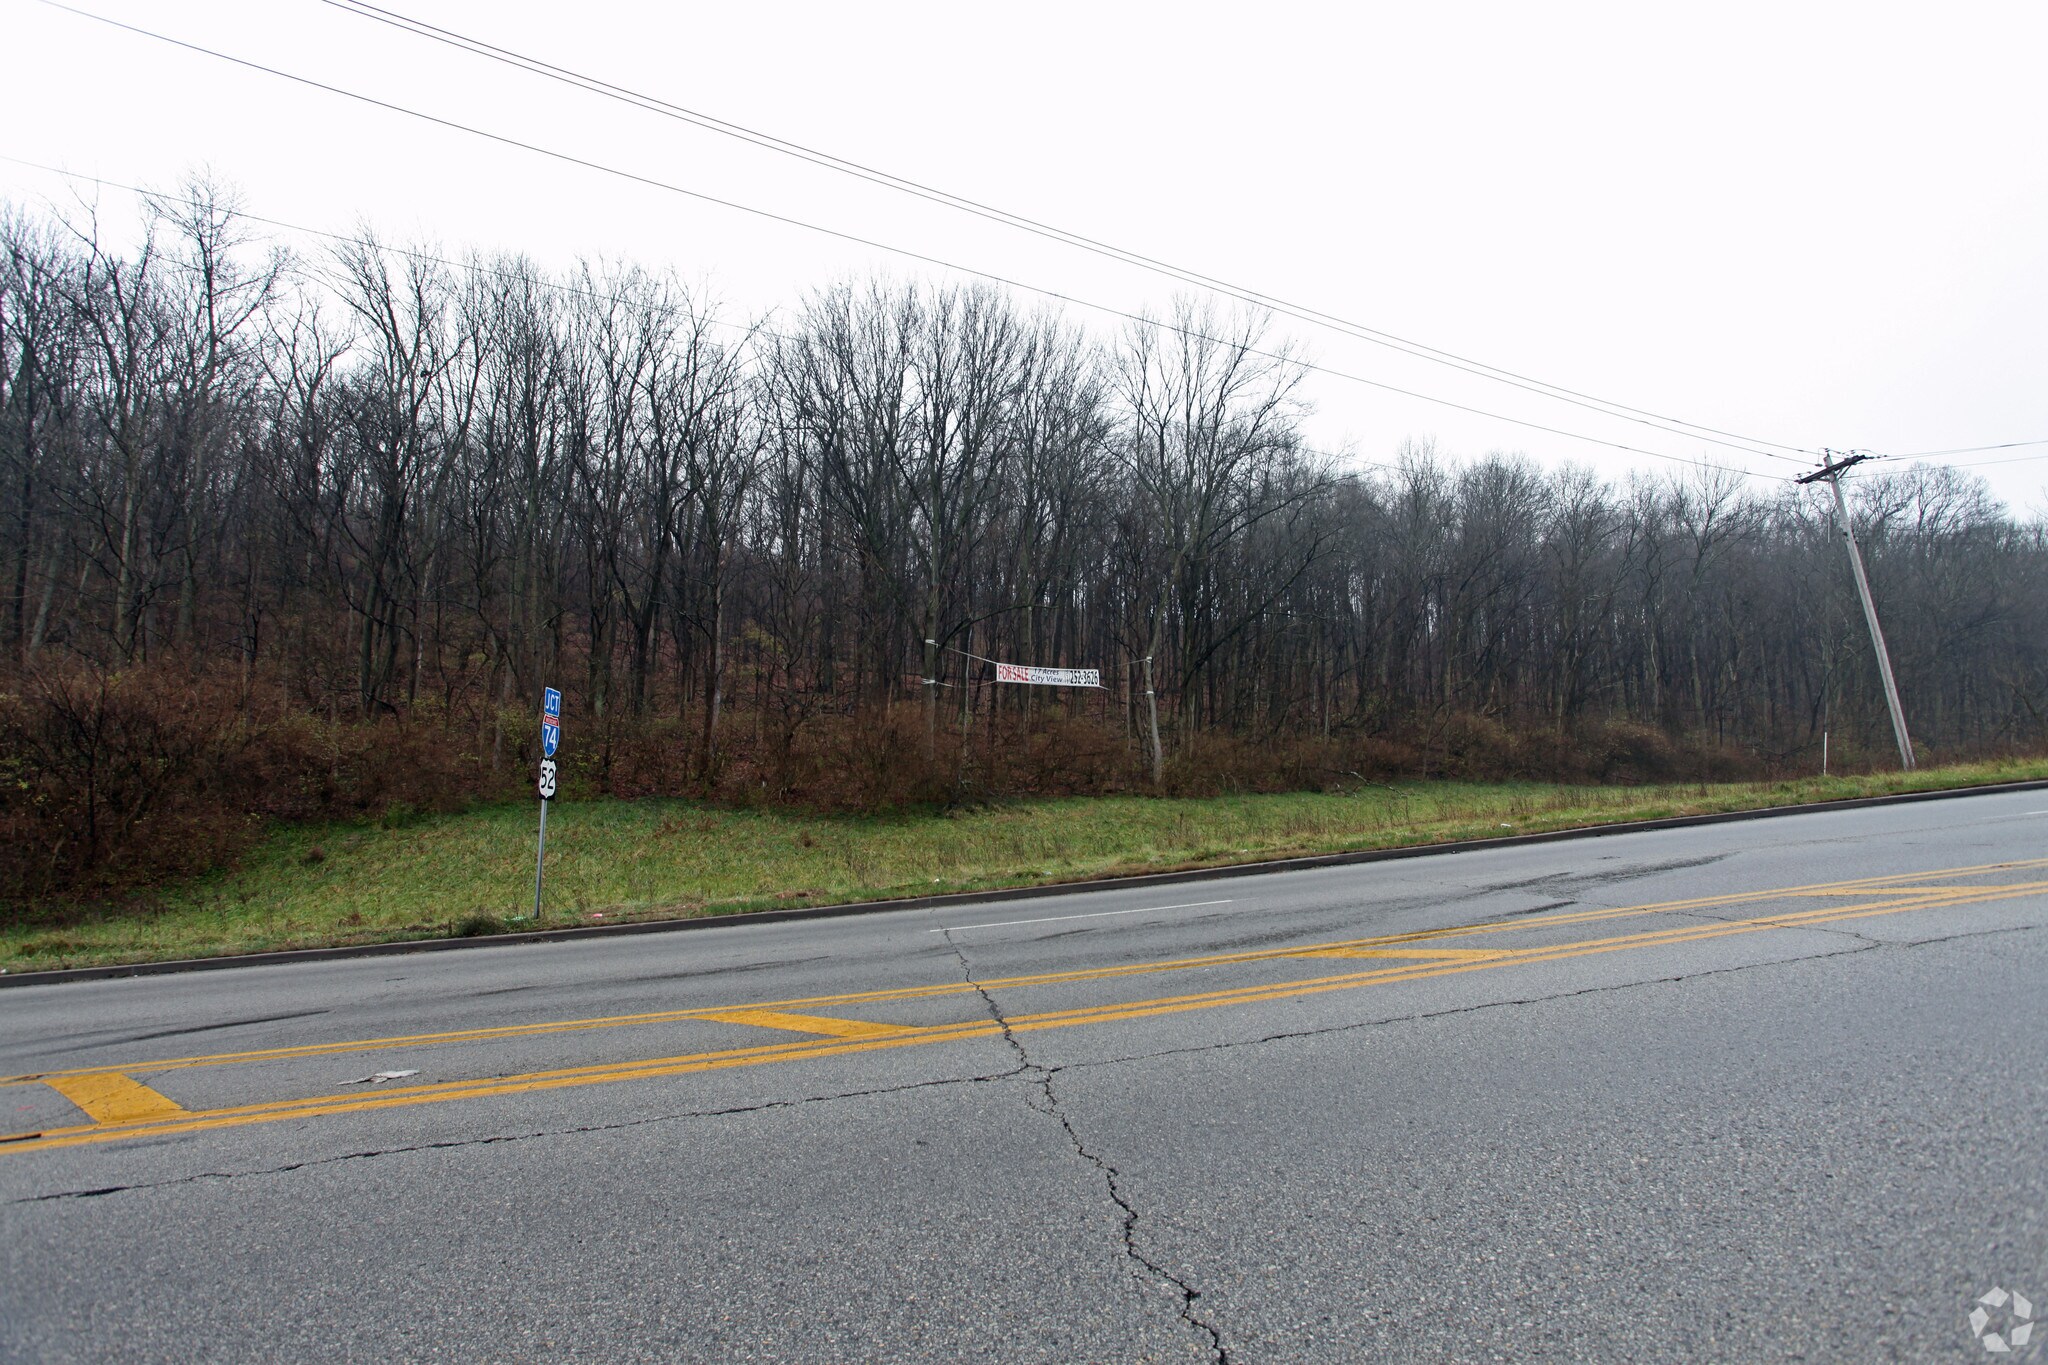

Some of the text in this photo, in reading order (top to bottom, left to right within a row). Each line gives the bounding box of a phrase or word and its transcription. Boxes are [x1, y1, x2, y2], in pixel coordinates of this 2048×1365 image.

[998, 665, 1029, 681] FOR SALE
[1031, 674, 1044, 683] City
[1046, 675, 1063, 683] View
[546, 693, 559, 712] JCT
[544, 725, 557, 749] 74
[541, 767, 554, 789] 52
